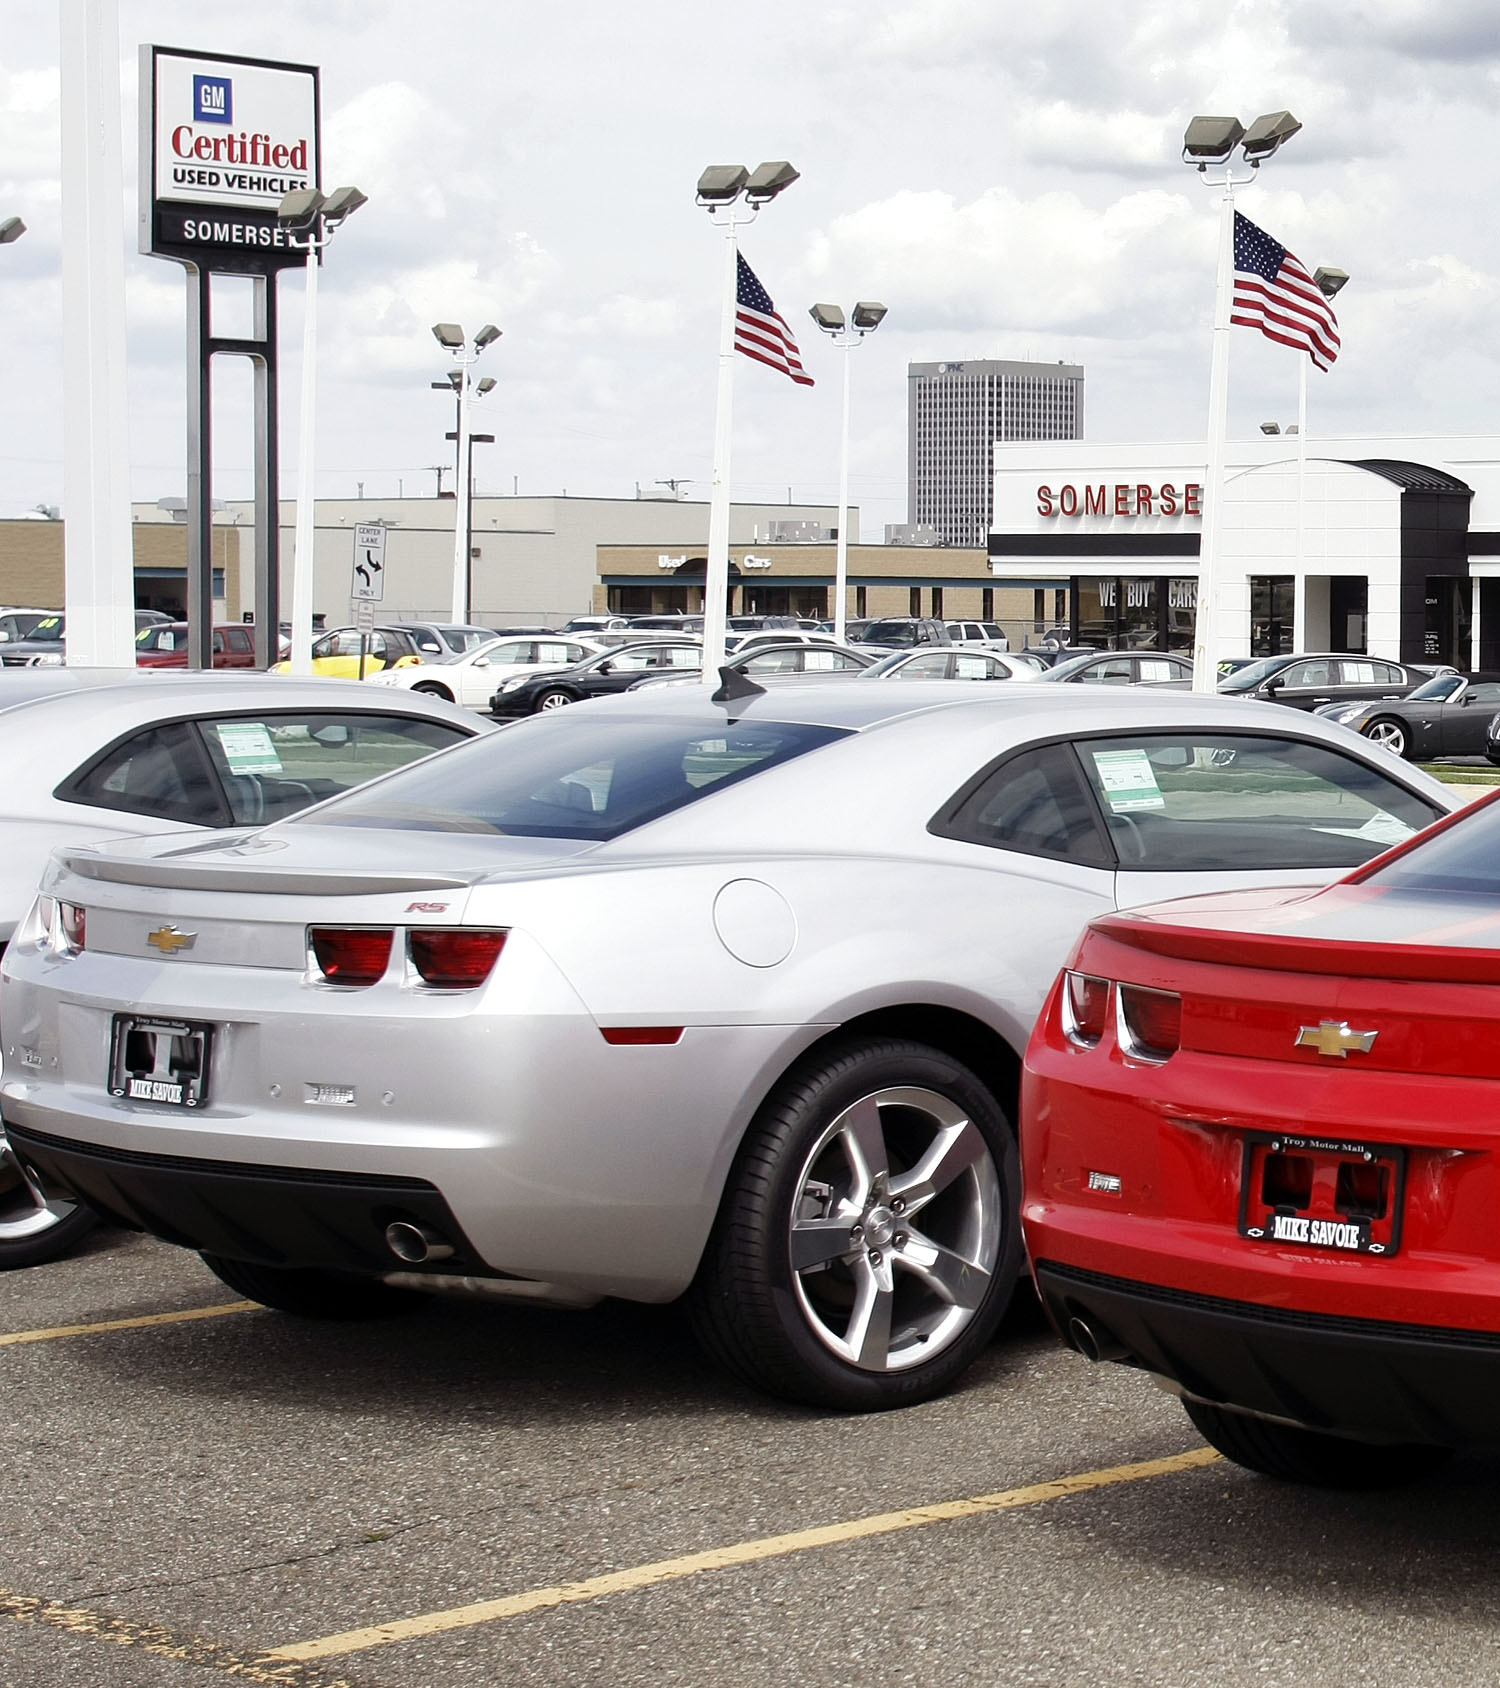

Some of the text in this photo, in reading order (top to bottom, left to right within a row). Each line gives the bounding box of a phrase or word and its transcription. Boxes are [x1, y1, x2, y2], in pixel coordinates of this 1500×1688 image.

[201, 84, 225, 108] GM
[171, 125, 308, 171] Certified
[173, 168, 308, 194] USED VEHICLES
[1037, 483, 1201, 517] SOMERSE
[743, 555, 772, 568] Cars
[1099, 581, 1198, 608] WE BUY CARS
[403, 902, 451, 913] RS
[129, 1079, 183, 1103] MIKE SAVOIE
[1282, 1136, 1365, 1153] Troy Motor Mall
[1273, 1216, 1360, 1249] MIKE SAVOIE
